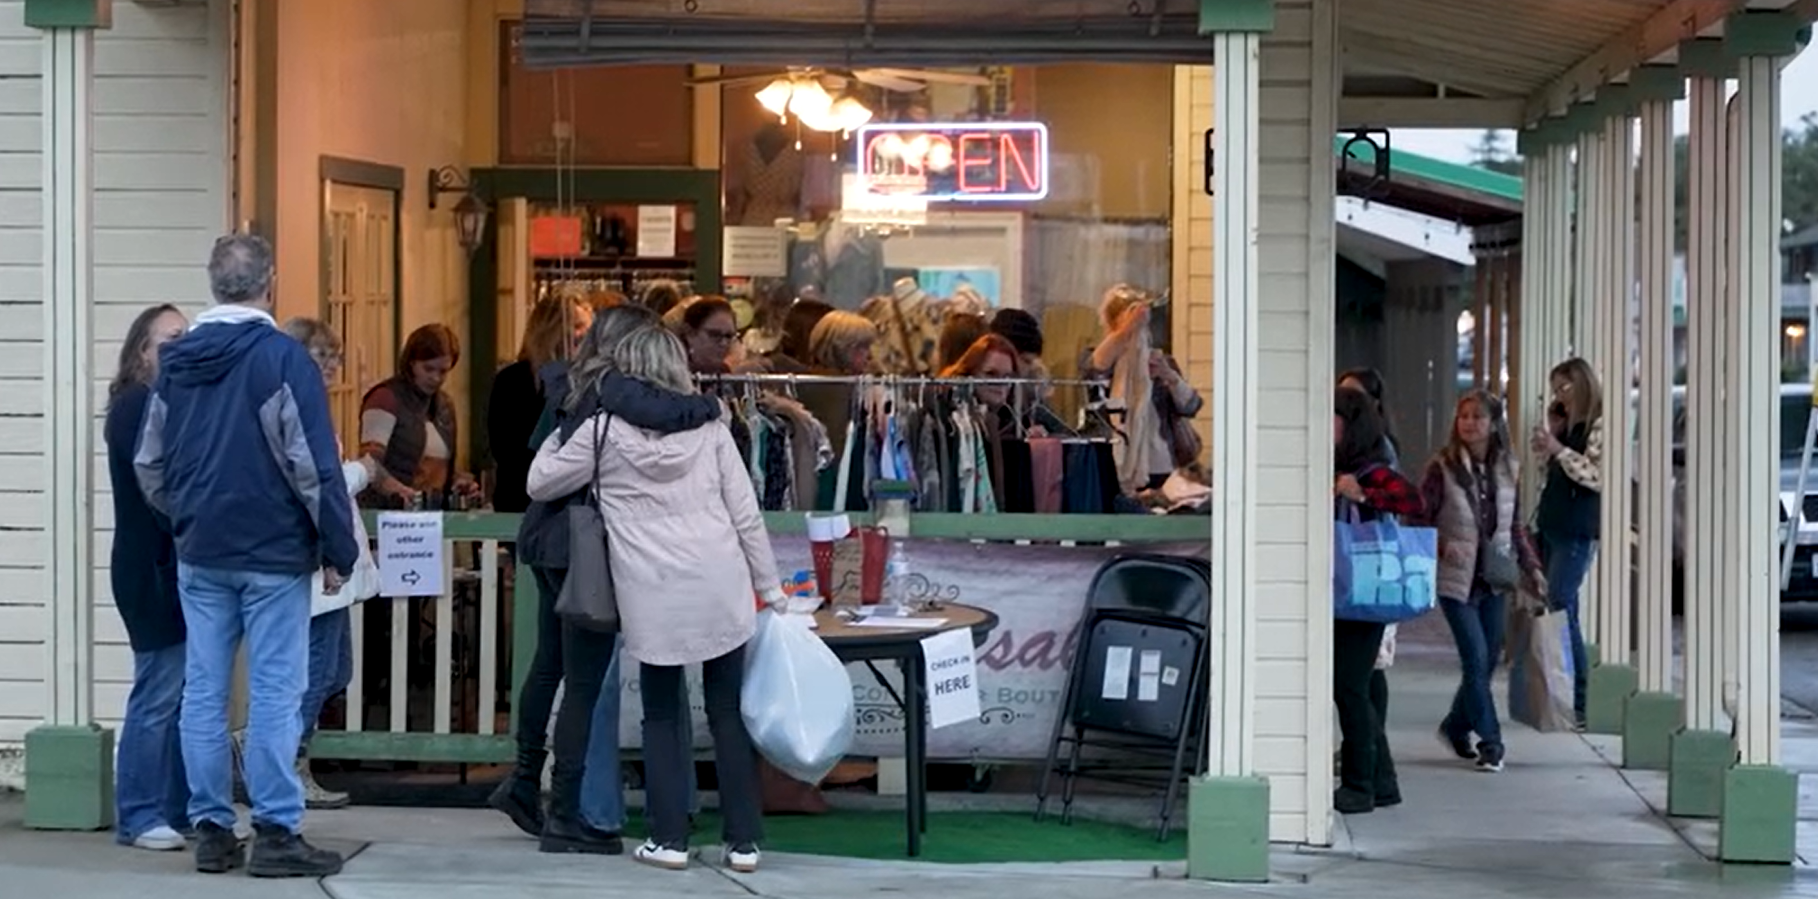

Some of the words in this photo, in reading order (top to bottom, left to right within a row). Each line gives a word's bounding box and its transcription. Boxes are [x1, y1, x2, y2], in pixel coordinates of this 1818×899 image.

[865, 131, 1040, 192] OPEN
[381, 520, 416, 530] Please
[396, 535, 425, 544] other
[387, 551, 434, 560] entrance
[934, 674, 972, 696] HERE
[997, 686, 1060, 705] BOUT
